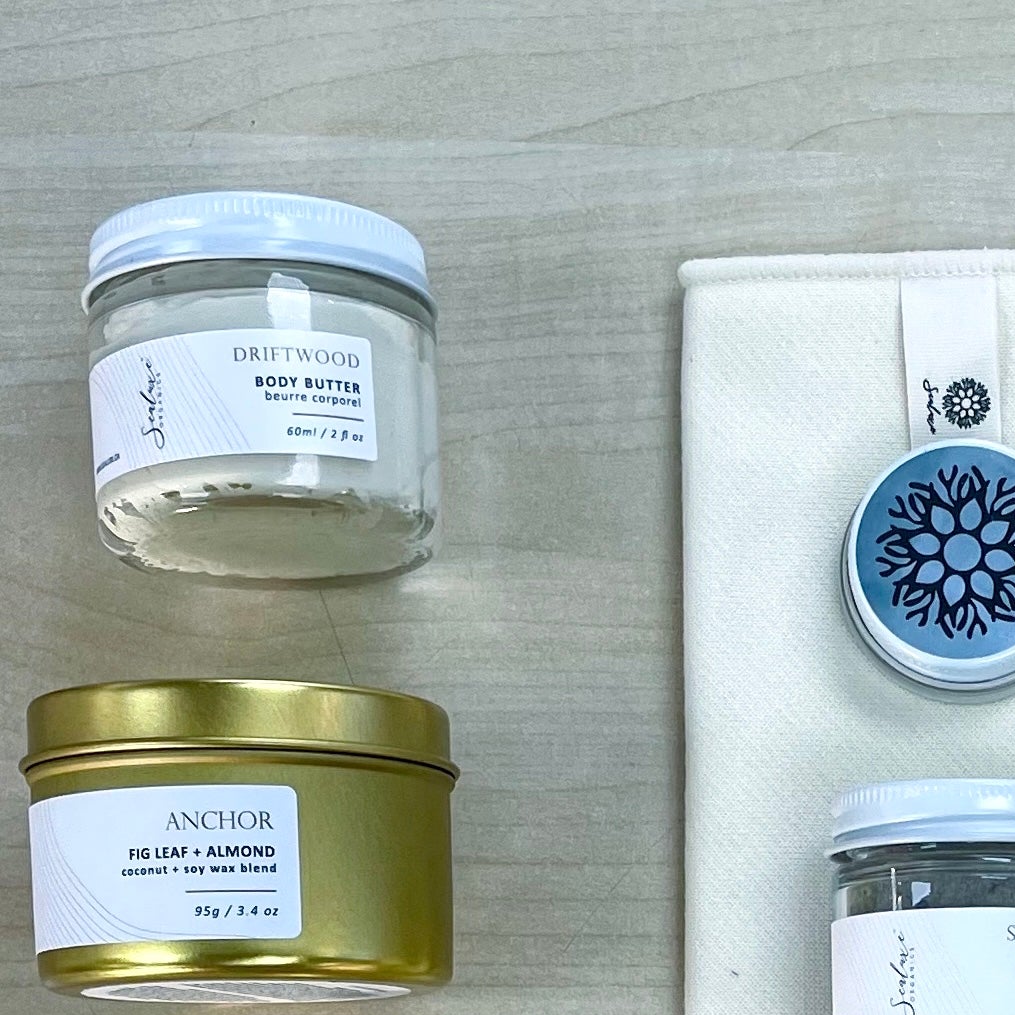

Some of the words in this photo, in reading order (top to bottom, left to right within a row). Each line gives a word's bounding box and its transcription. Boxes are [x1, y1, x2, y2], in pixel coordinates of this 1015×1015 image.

[234, 347, 359, 368] DRIFTWOOD
[255, 376, 297, 387] BODY
[304, 378, 361, 394] BUTTER
[265, 390, 307, 401] beurre
[312, 392, 361, 407] corporel
[287, 427, 316, 436] 60ml
[320, 428, 327, 439] /
[331, 430, 336, 438] 2
[352, 434, 363, 442] oz
[166, 811, 274, 830] ANCHOR
[129, 848, 150, 860] FIG
[155, 847, 188, 859] LEAF
[193, 848, 201, 857] +
[206, 846, 275, 857] ALMOND
[122, 866, 167, 876] coconut
[184, 866, 205, 875] soy
[241, 863, 276, 873] blend
[195, 906, 219, 918] 95g
[224, 905, 232, 918] /
[237, 906, 258, 916] 3.4
[264, 908, 278, 916] oz
